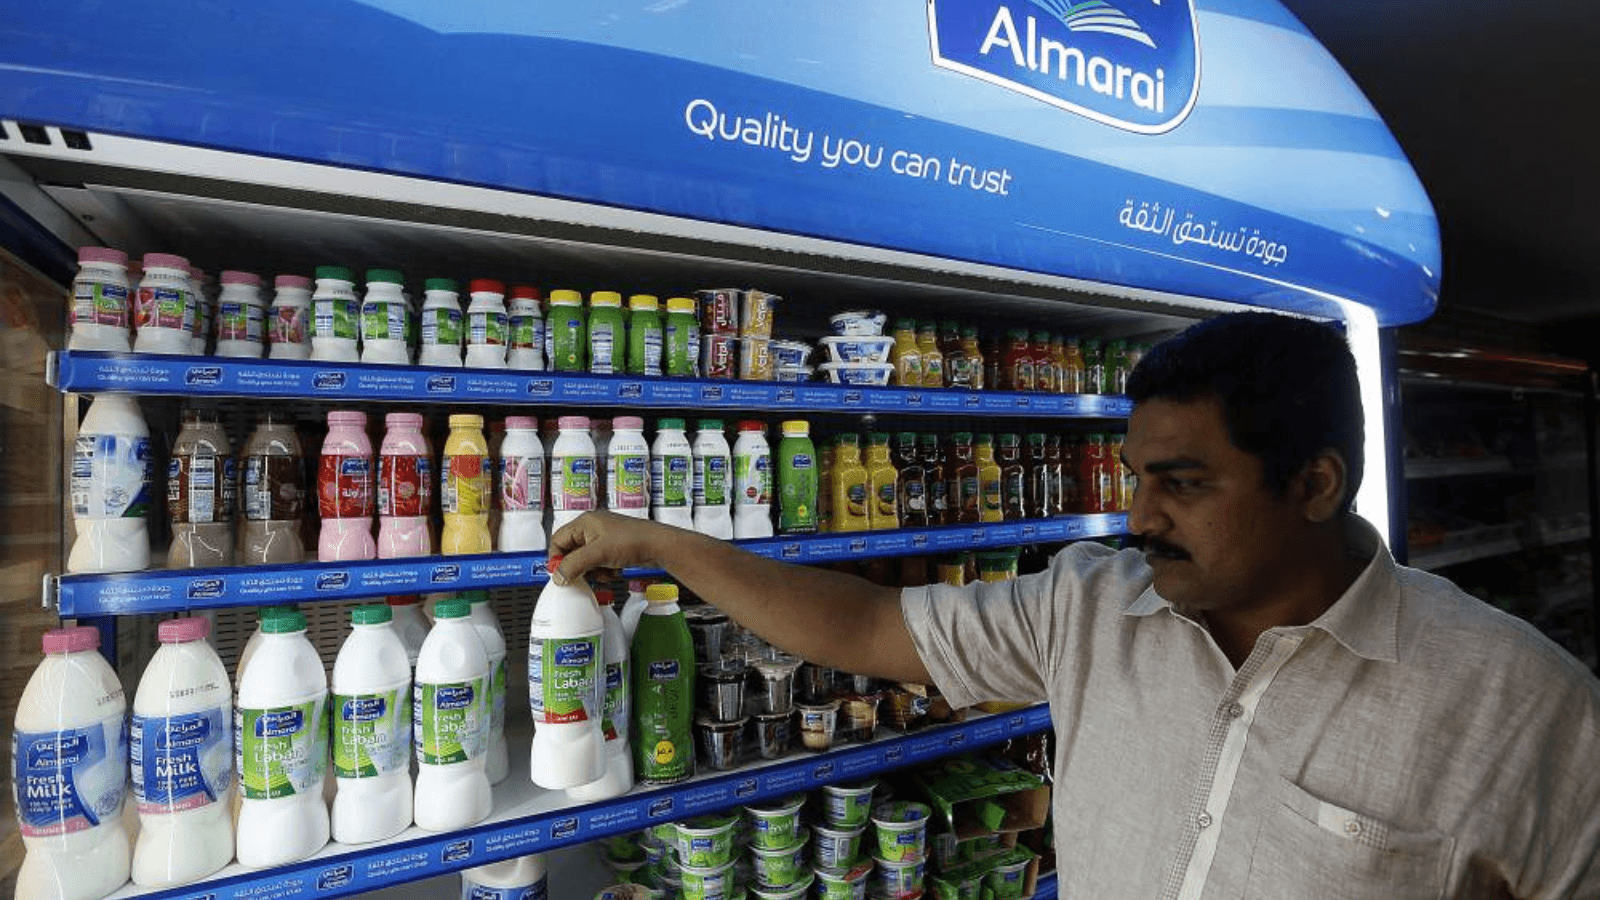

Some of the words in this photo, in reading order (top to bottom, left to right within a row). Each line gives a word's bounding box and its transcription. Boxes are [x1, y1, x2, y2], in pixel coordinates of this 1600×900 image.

[979, 5, 1165, 113] Almarai
[685, 99, 813, 162] Quality
[821, 136, 884, 168] you
[891, 150, 941, 181] can
[948, 157, 1013, 195] trust
[1119, 199, 1175, 236] الثقة
[1172, 213, 1245, 252] تستحق
[1245, 229, 1288, 267] جودة
[554, 677, 594, 689] Laban
[156, 753, 191, 766] Fresh
[156, 763, 198, 778] Milk
[26, 774, 65, 786] Fresh
[26, 783, 72, 799] Milk
